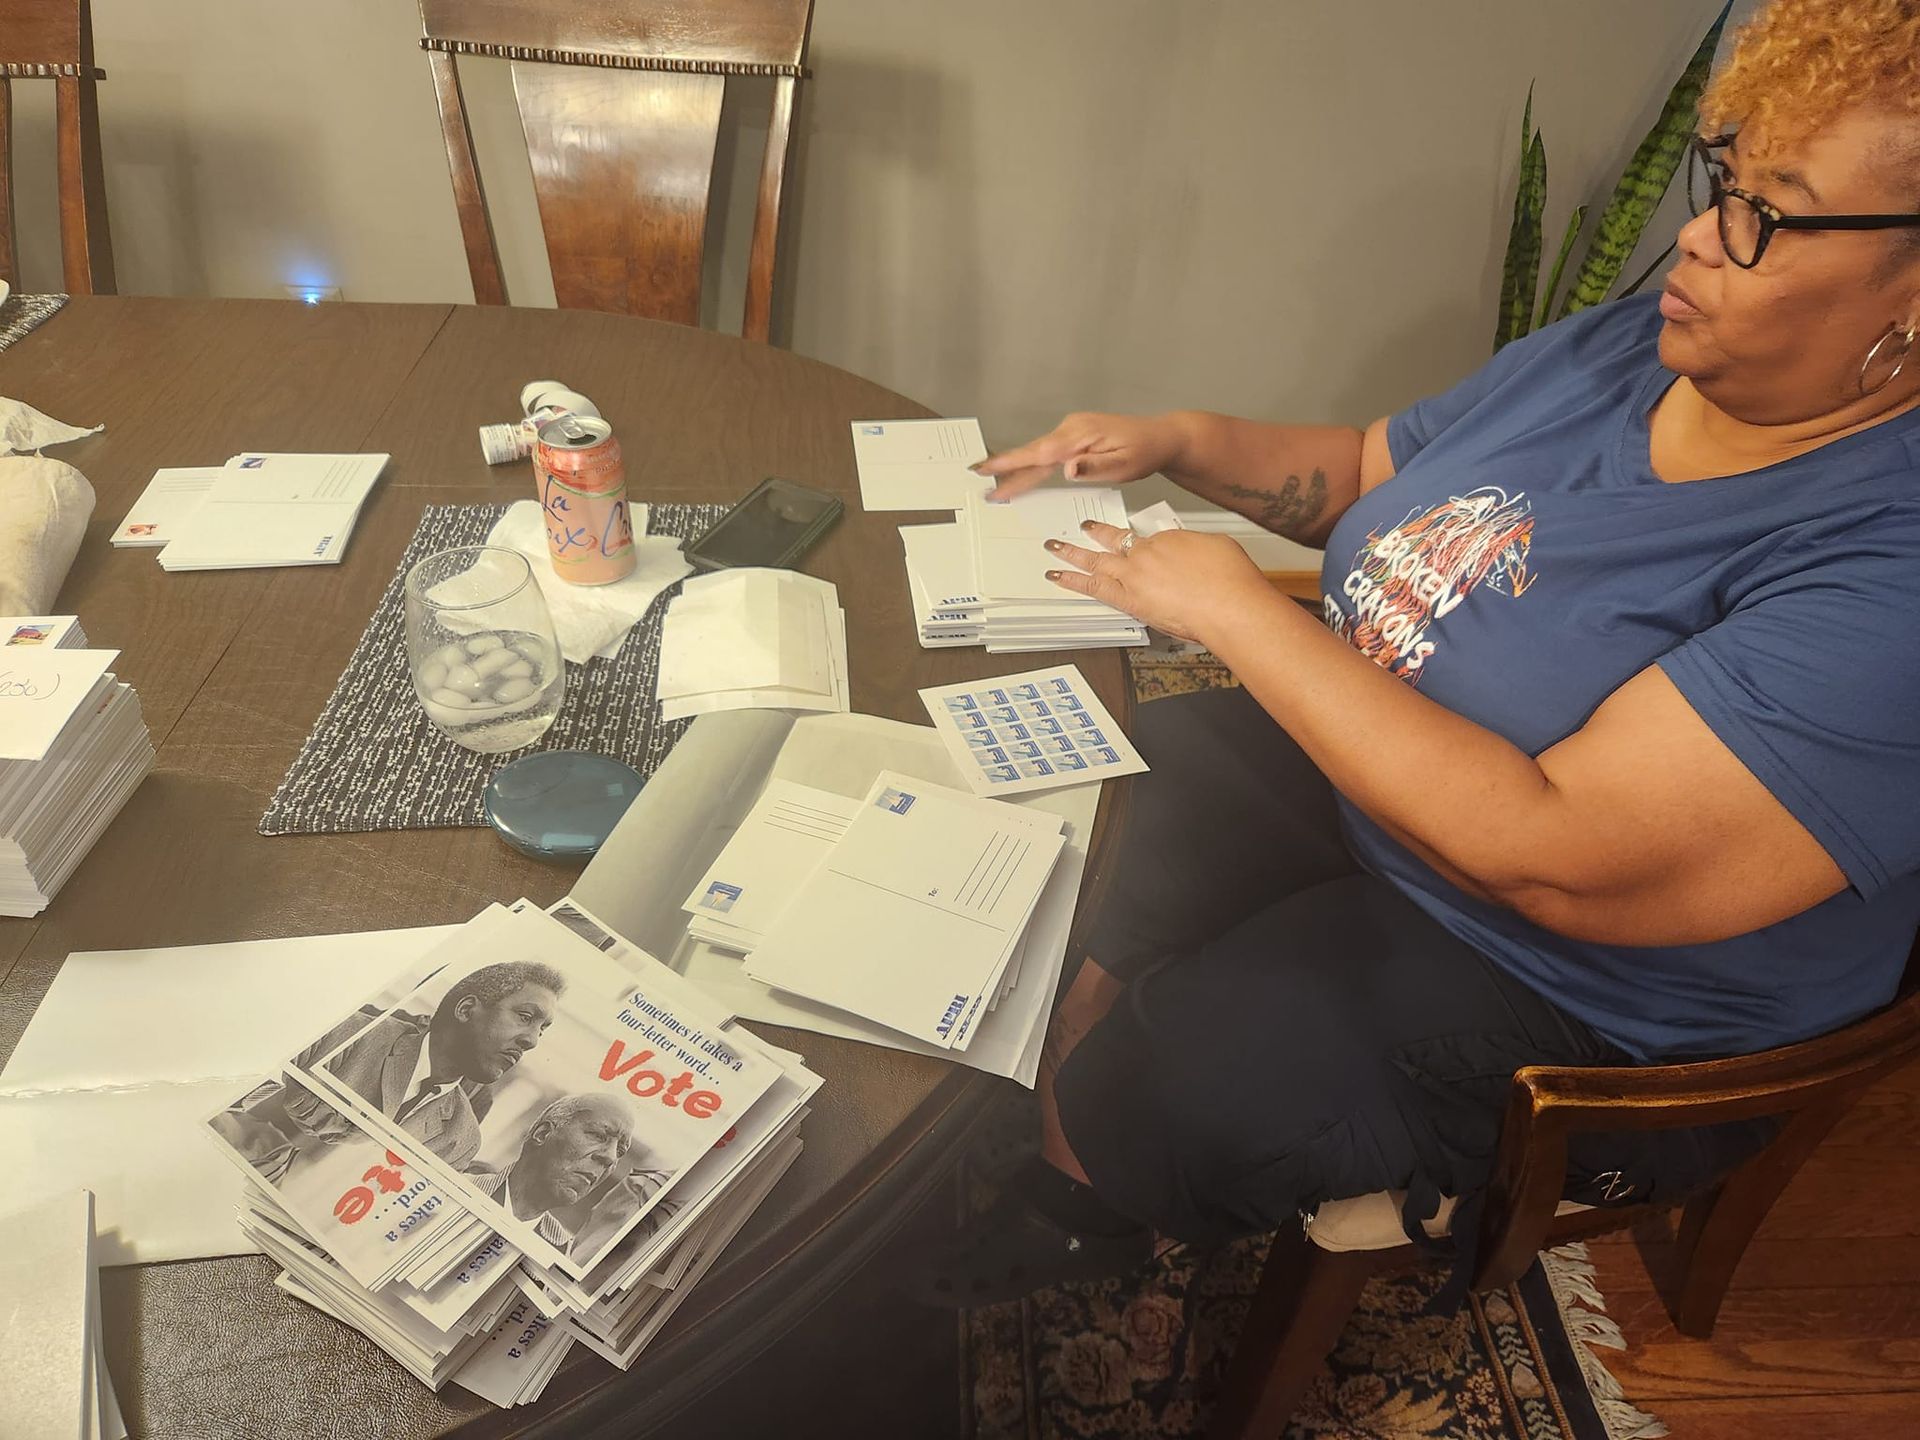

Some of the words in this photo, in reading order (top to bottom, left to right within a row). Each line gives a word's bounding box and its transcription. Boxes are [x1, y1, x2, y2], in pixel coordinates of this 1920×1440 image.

[543, 475, 571, 522] La
[1374, 530, 1463, 618] BROKEN
[1343, 570, 1435, 669] CRAYONS
[617, 1008, 676, 1051] four-letter
[628, 992, 691, 1037] Sometimes
[689, 1031, 702, 1044] it
[700, 1039, 734, 1065] takes
[732, 1060, 744, 1072] a
[598, 1039, 722, 1119] Vote
[399, 1195, 442, 1231] takes
[385, 1230, 398, 1242] a
[469, 1238, 506, 1272] akes
[457, 1272, 470, 1283] a
[519, 1312, 548, 1346] akes
[508, 1347, 521, 1358] a
